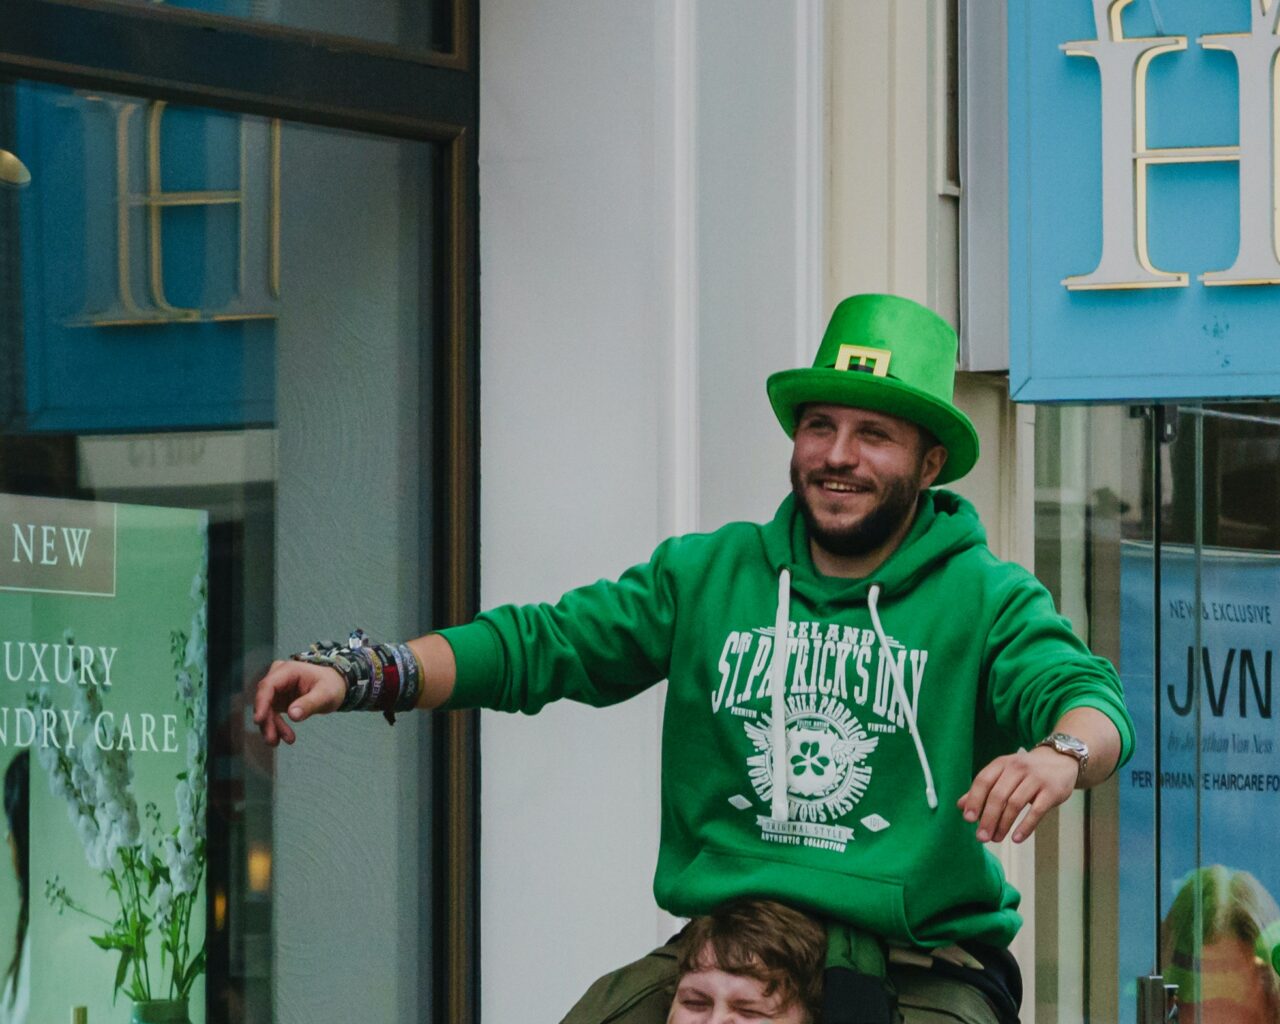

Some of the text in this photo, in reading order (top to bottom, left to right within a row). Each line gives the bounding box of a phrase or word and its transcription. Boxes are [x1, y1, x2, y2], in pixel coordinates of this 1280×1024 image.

[12, 523, 92, 568] NEW
[1213, 602, 1272, 624] EXCLUSIVE
[786, 620, 876, 647] RELAND
[872, 650, 928, 734] DAY
[1167, 646, 1272, 719] JVN
[94, 710, 179, 752] CARE
[867, 722, 896, 734] VINTAGE
[1181, 731, 1229, 753] Joathan
[824, 766, 873, 820] FESTIVAL
[1132, 771, 1210, 790] PERORMANE
[1212, 773, 1264, 792] HAIRCARE
